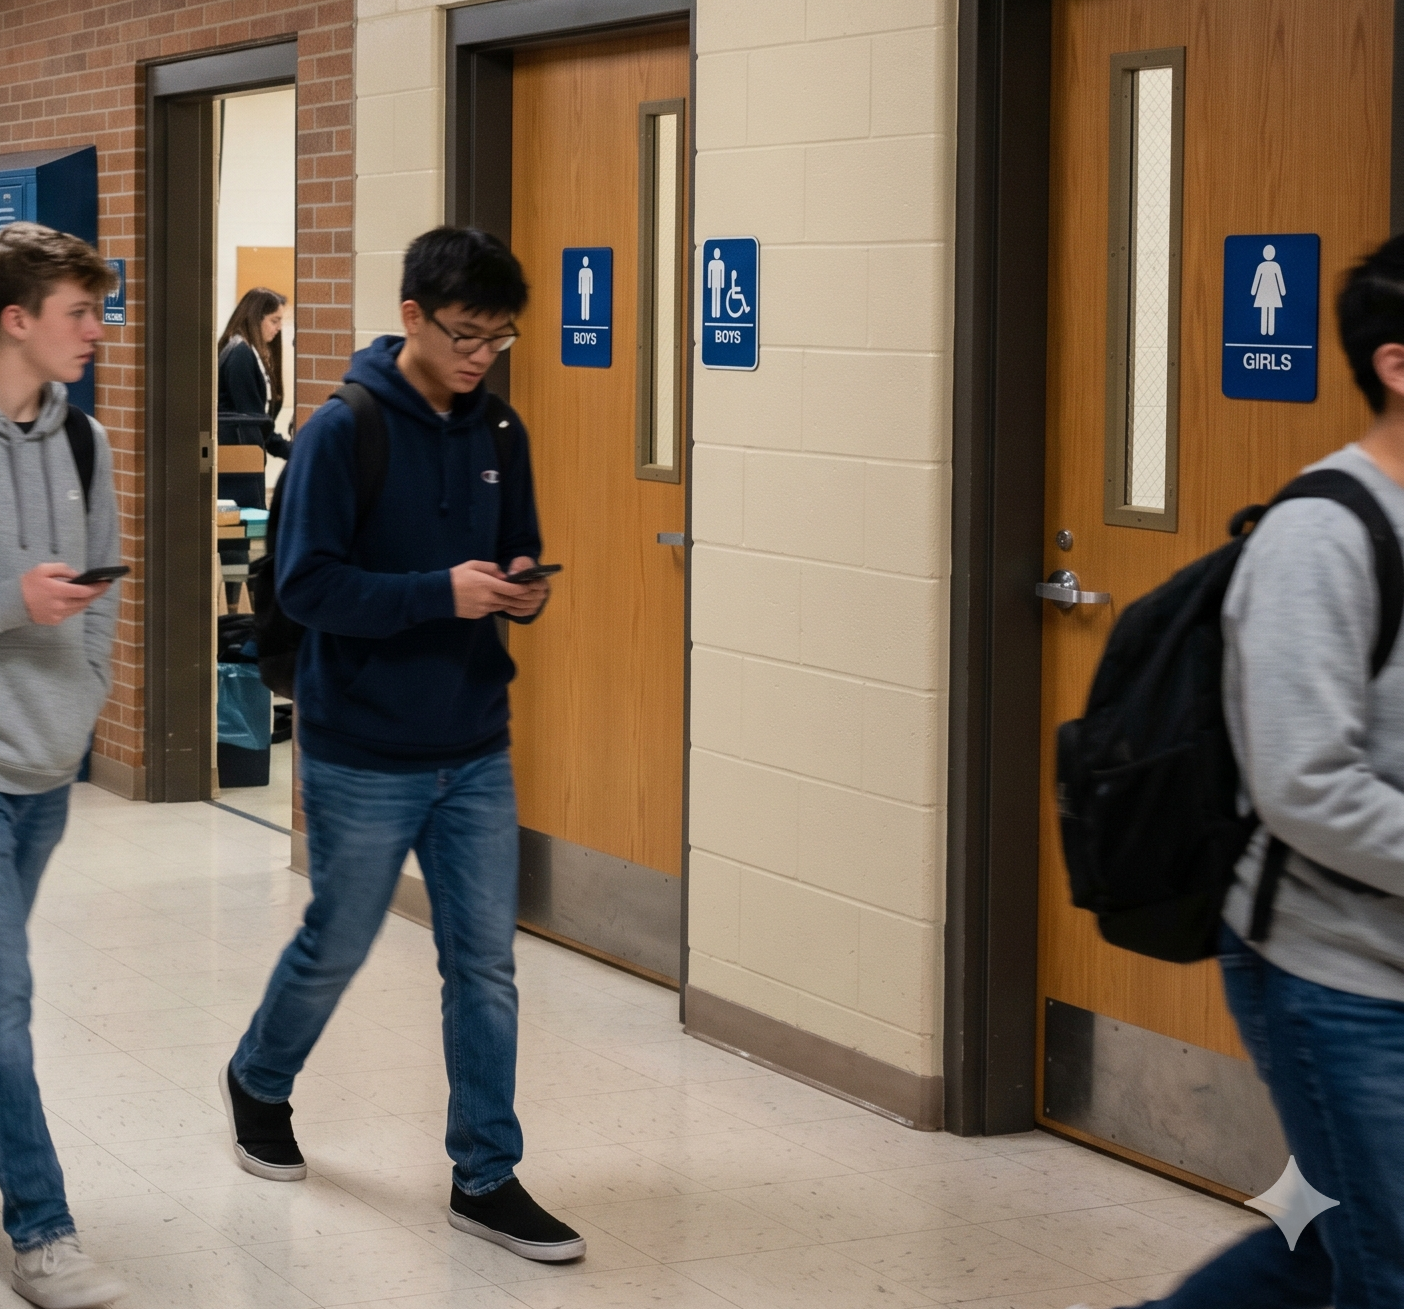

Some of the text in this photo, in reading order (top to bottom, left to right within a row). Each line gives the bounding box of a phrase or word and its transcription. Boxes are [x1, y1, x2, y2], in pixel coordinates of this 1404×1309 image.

[573, 332, 597, 345] BOYS
[715, 330, 741, 344] BOYS
[1243, 352, 1292, 371] GIRLS
